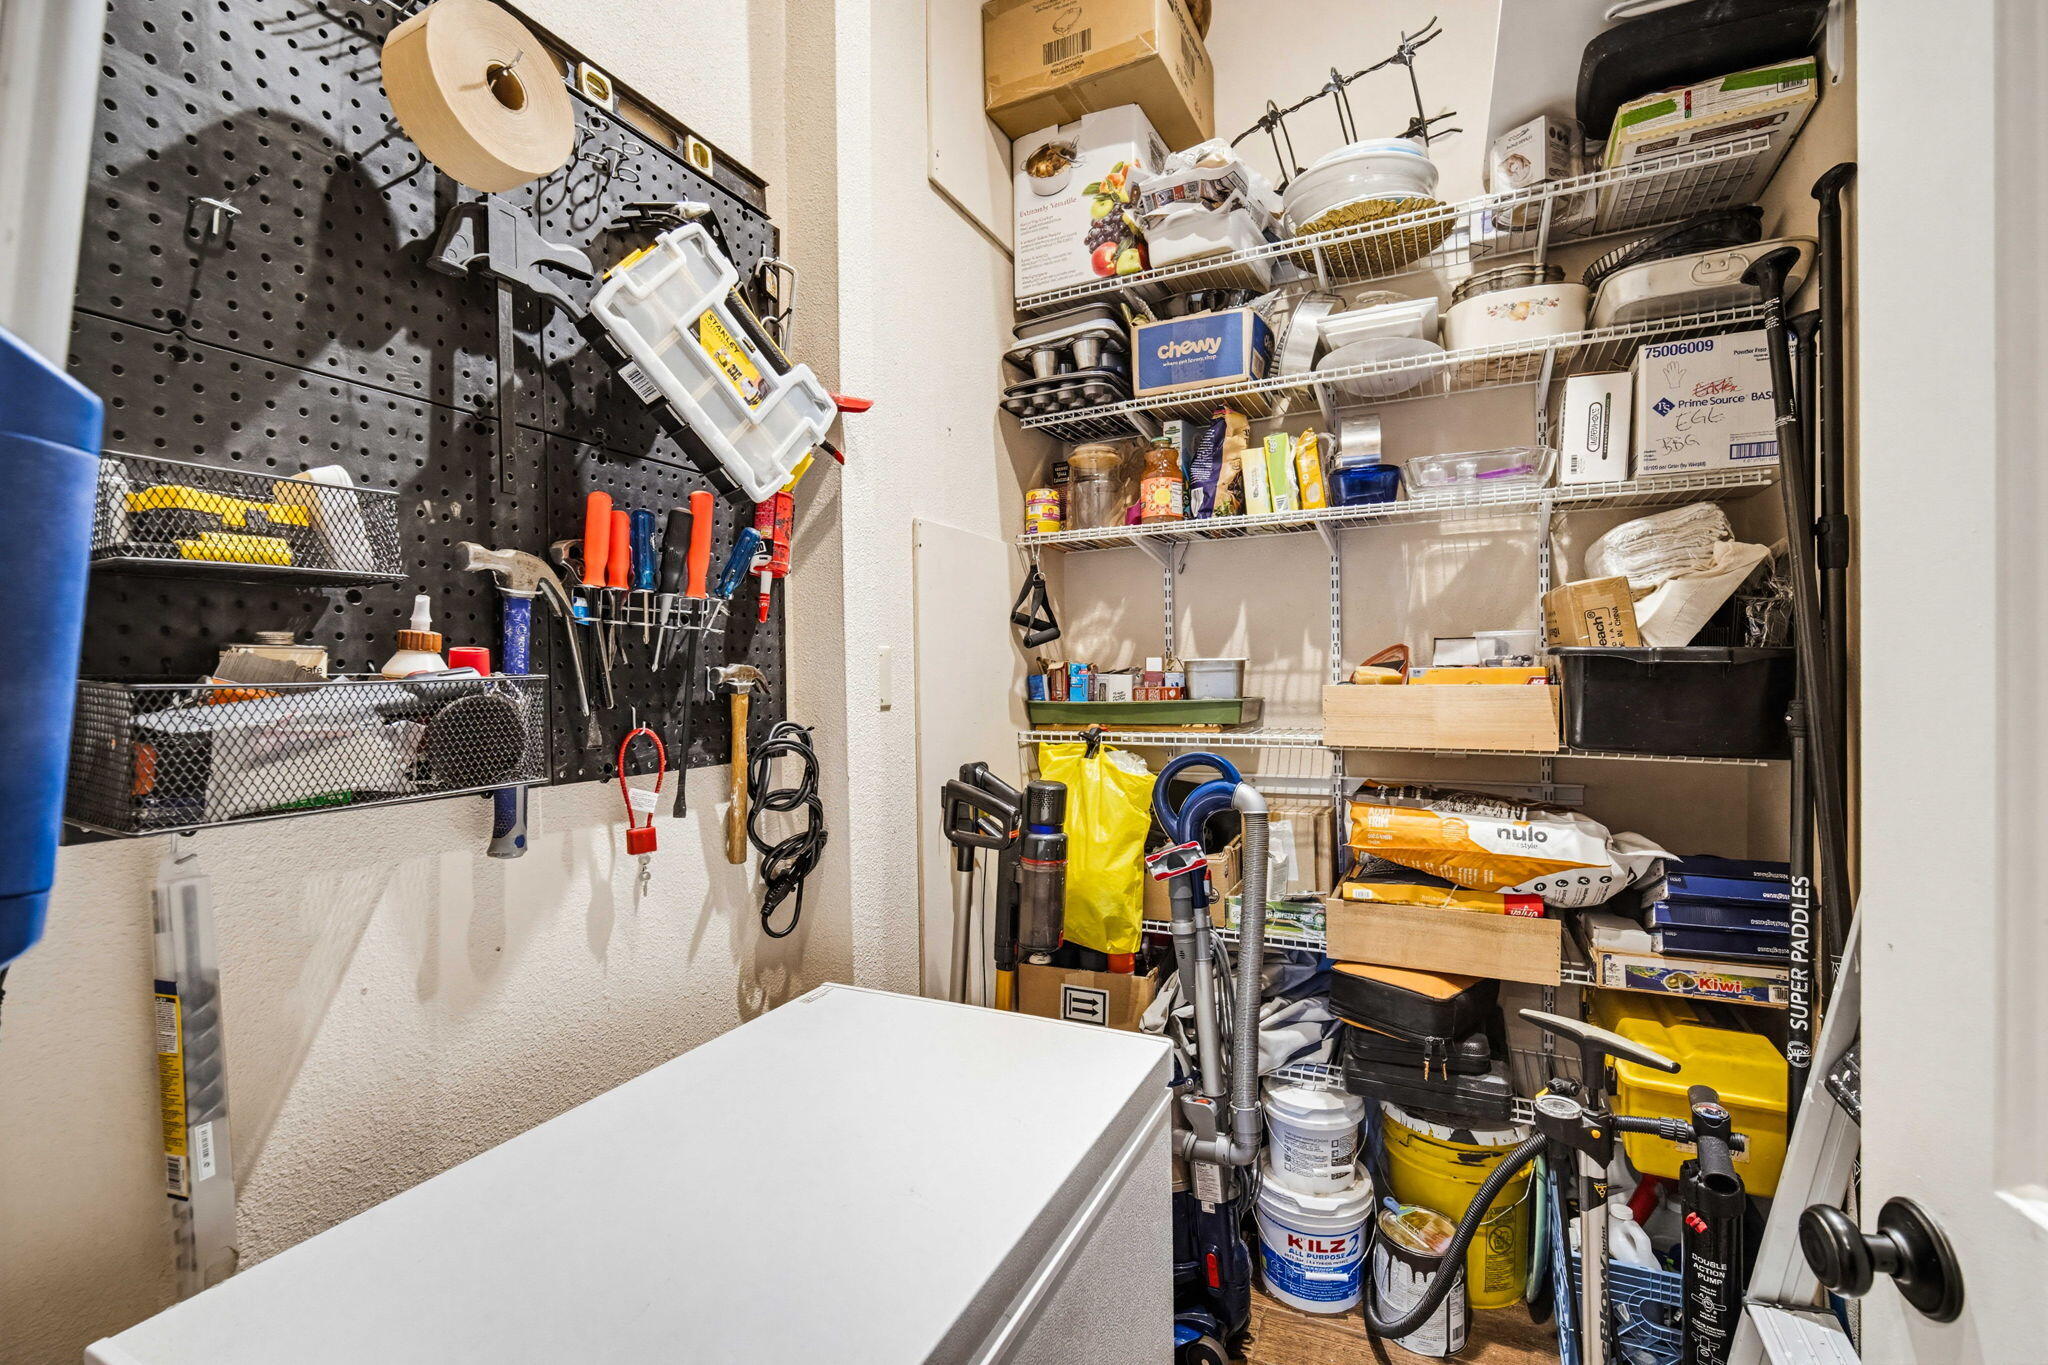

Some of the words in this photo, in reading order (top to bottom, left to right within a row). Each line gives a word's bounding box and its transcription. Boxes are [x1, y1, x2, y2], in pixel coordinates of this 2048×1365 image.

[1050, 197, 1077, 209] Versatile
[707, 313, 740, 353] STANLEY
[1157, 336, 1222, 359] chewy
[1644, 339, 1714, 359] 75006009
[1678, 397, 1707, 409] Prime
[1709, 394, 1746, 406] Source
[300, 665, 323, 675] Safe
[1497, 824, 1549, 844] nulo
[1789, 875, 1811, 963] PADDLES
[1699, 978, 1742, 993] Kiwi
[1789, 969, 1809, 1031] SUPER
[1288, 1234, 1346, 1253] KILZ
[1288, 1248, 1304, 1258] ALL
[1306, 1252, 1346, 1261] PURPOSE
[1691, 1252, 1728, 1271] DOUBLE
[1693, 1262, 1726, 1279] ACTION
[1697, 1272, 1723, 1286] PUMP
